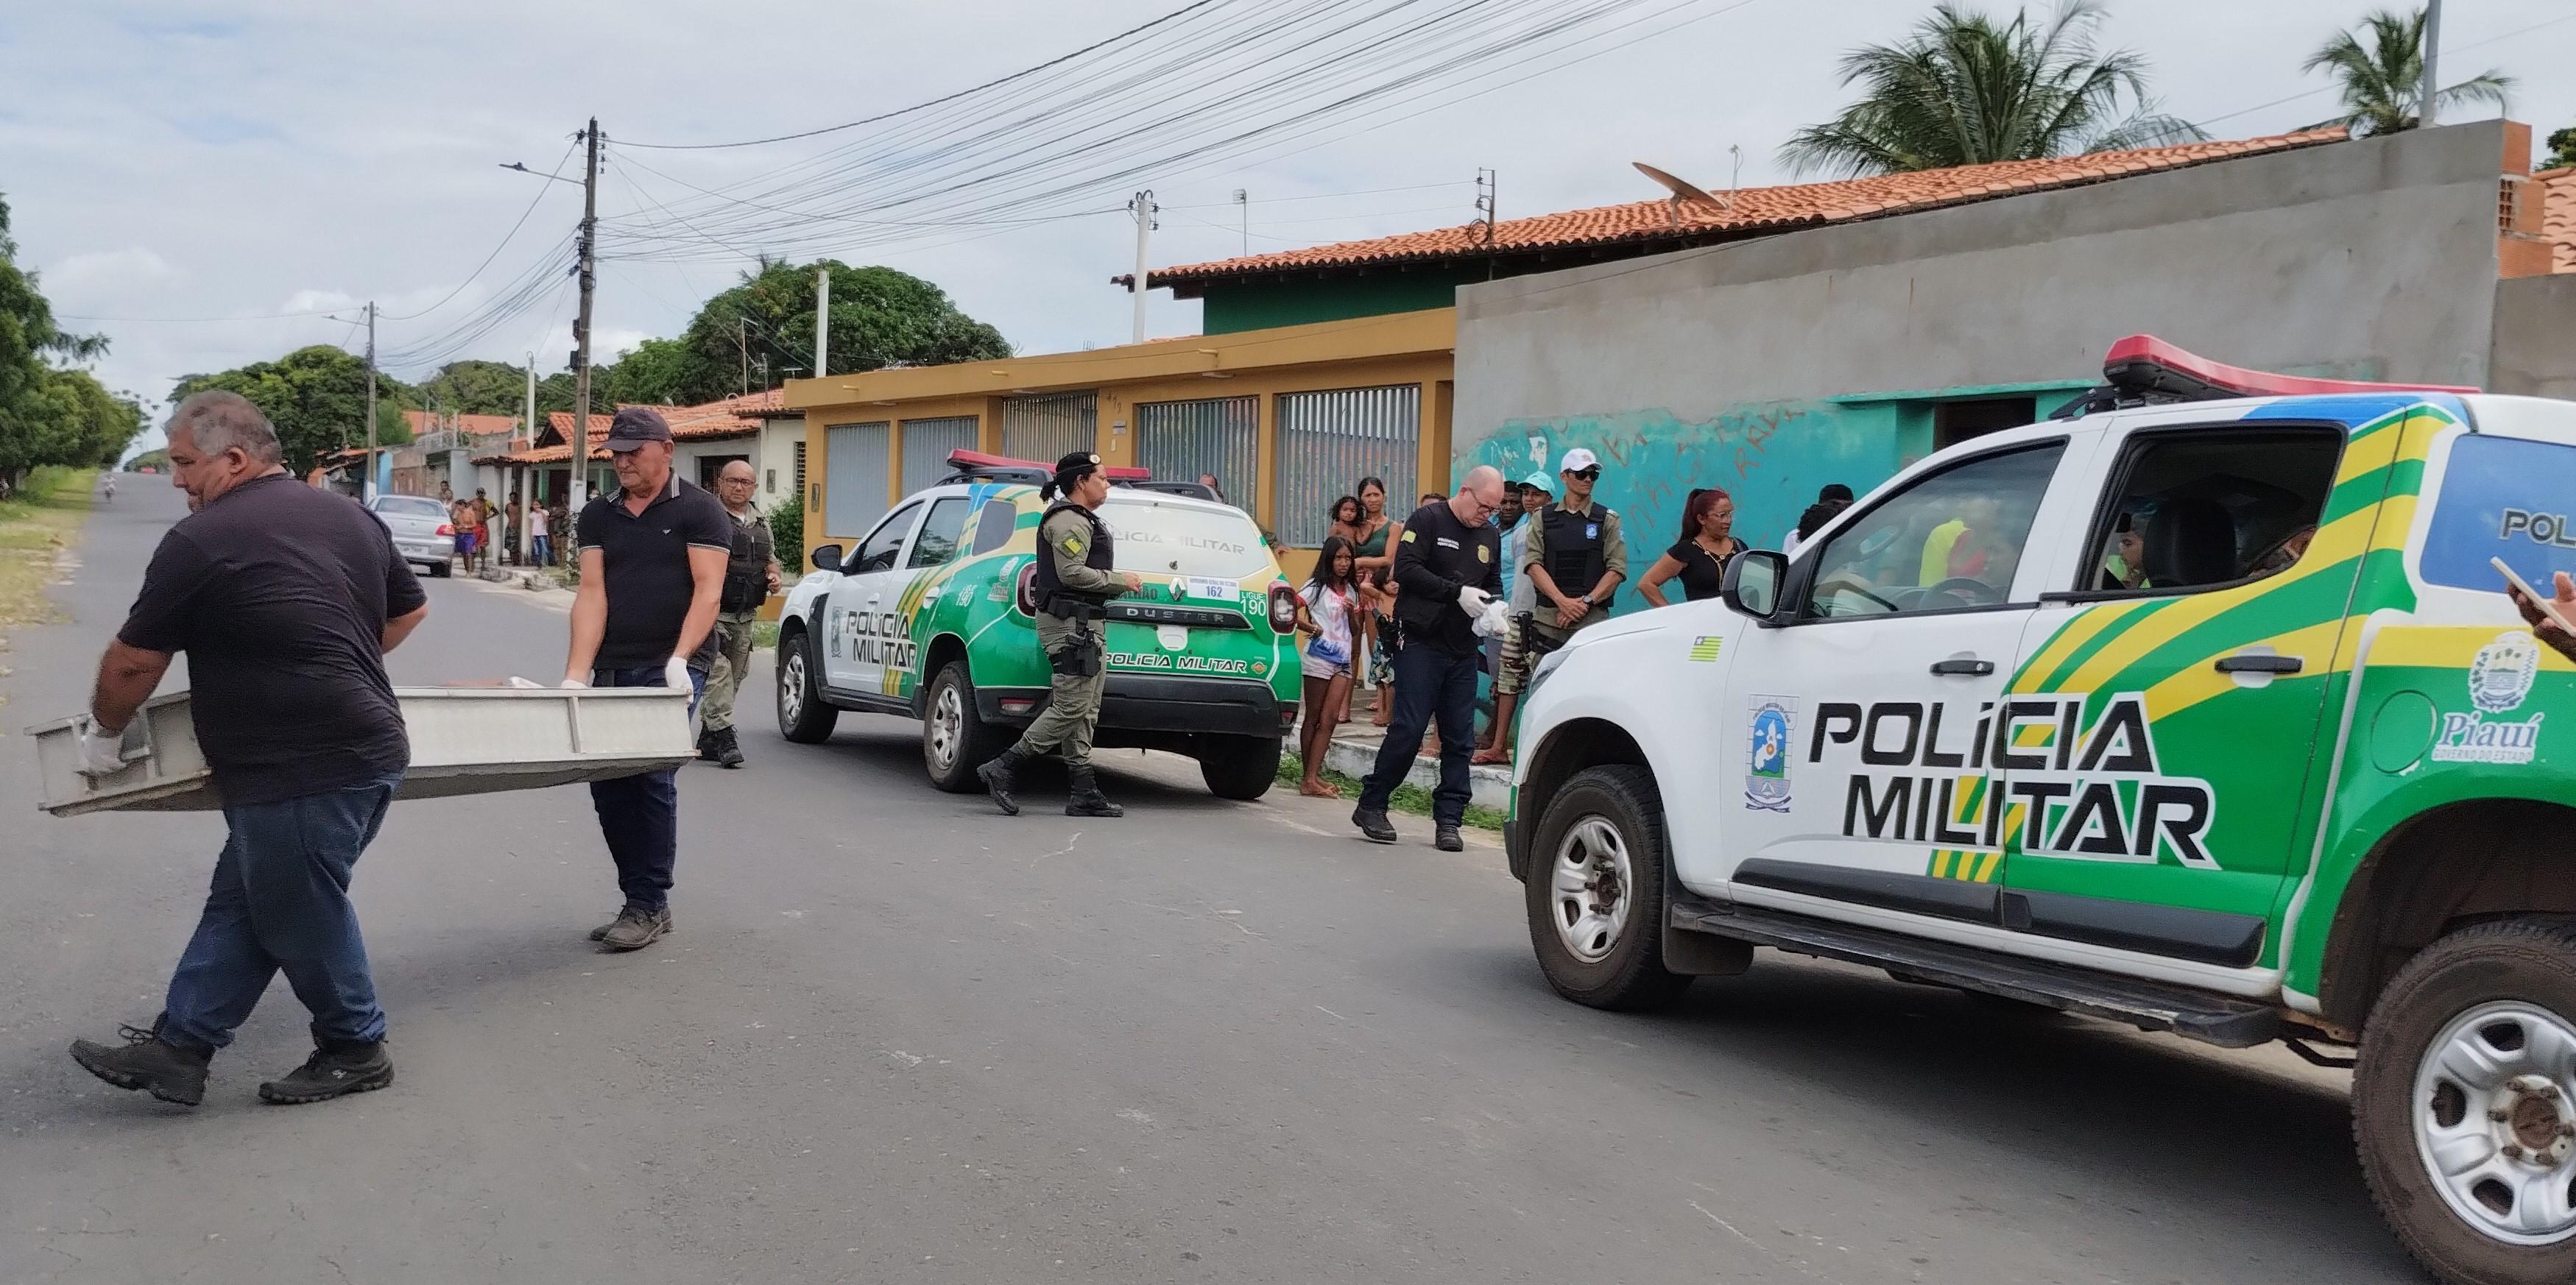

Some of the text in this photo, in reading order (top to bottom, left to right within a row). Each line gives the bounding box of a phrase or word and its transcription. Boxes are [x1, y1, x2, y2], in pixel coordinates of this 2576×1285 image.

[1206, 585, 1223, 598] 162
[1126, 608, 1224, 622] DUSTER
[1241, 598, 1266, 617] 190
[853, 638, 917, 670] MILITAR
[1177, 656, 1247, 673] MILITAR
[2438, 712, 2544, 748] Piauí
[1842, 774, 2207, 861] MILITAR
